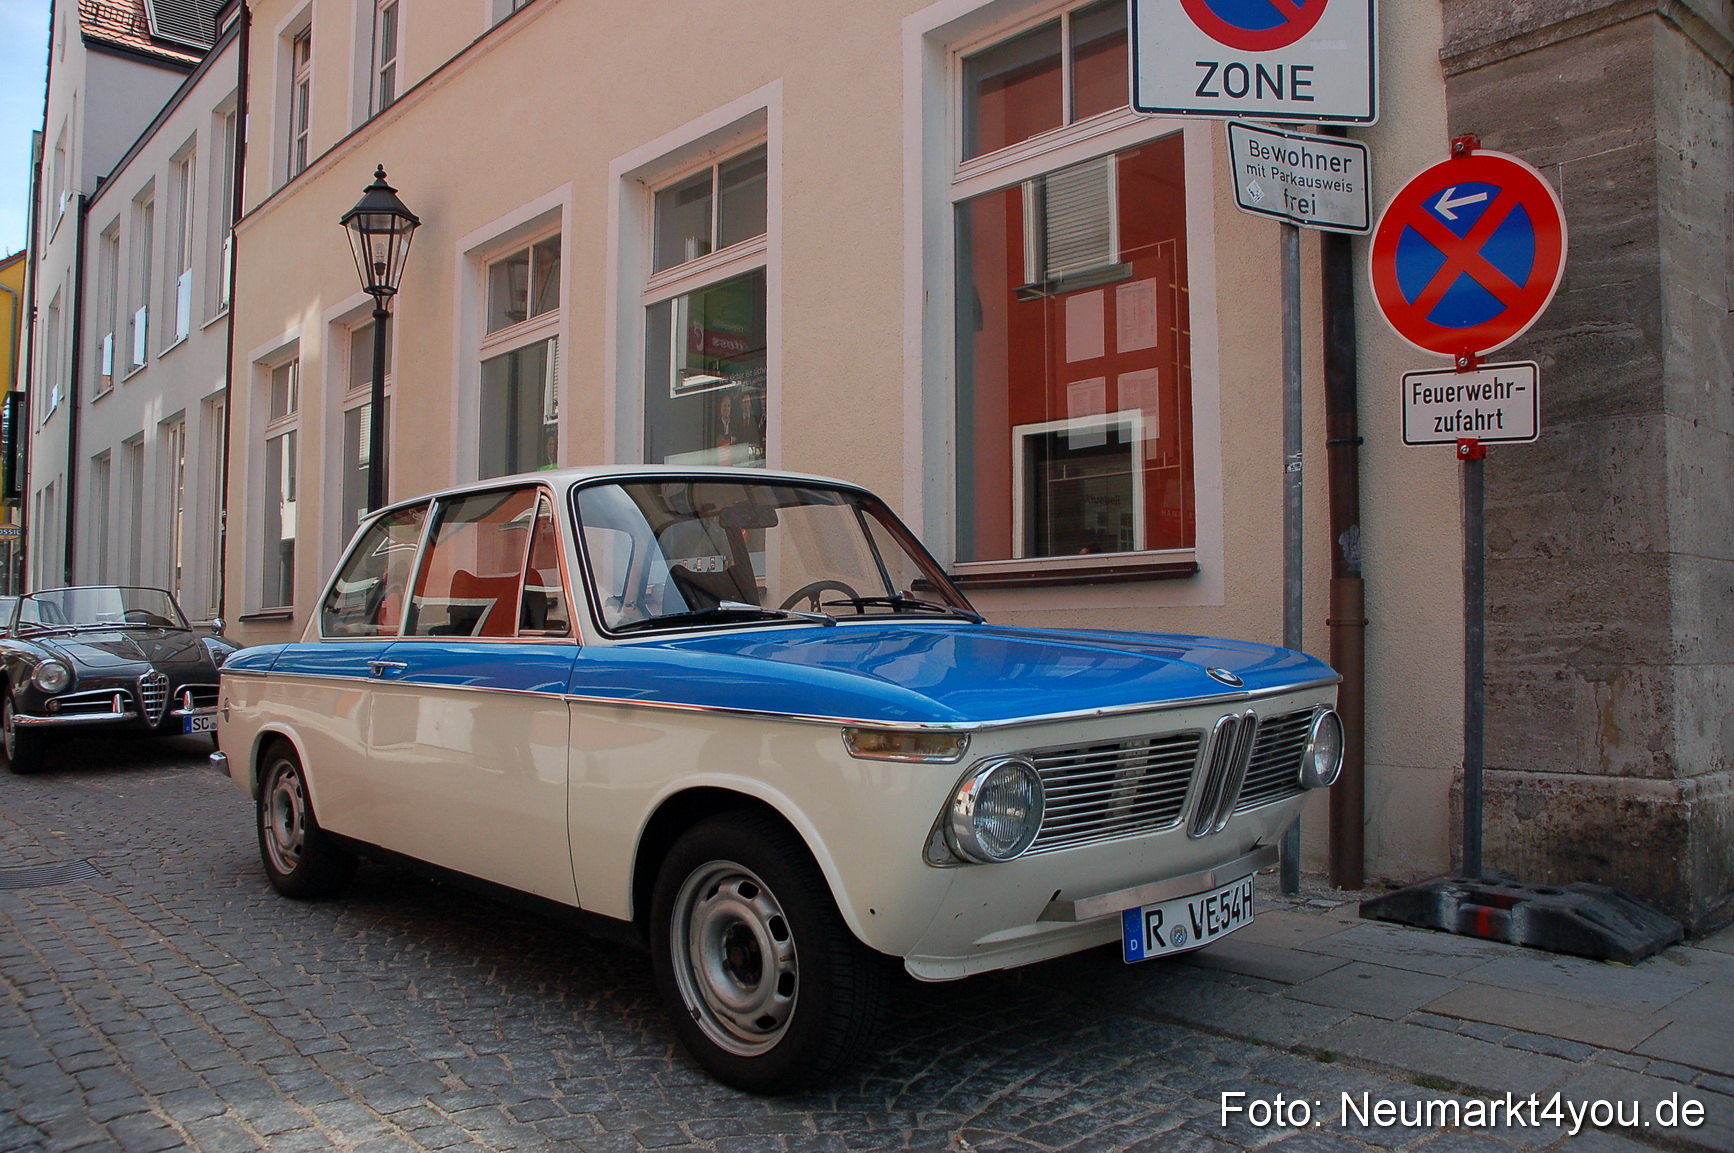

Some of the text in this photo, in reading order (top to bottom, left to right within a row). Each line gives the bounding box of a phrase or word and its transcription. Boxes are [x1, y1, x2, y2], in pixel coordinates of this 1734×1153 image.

[1195, 61, 1315, 101] ZONE
[1248, 139, 1353, 174] Bewohner
[1246, 163, 1353, 193] mit Parkausweis
[1283, 188, 1316, 215] frei
[1412, 376, 1526, 405] Feuerwehr-
[1433, 408, 1504, 433] zufahrt
[193, 718, 209, 731] SC
[1130, 939, 1138, 951] D
[1145, 909, 1166, 950] R
